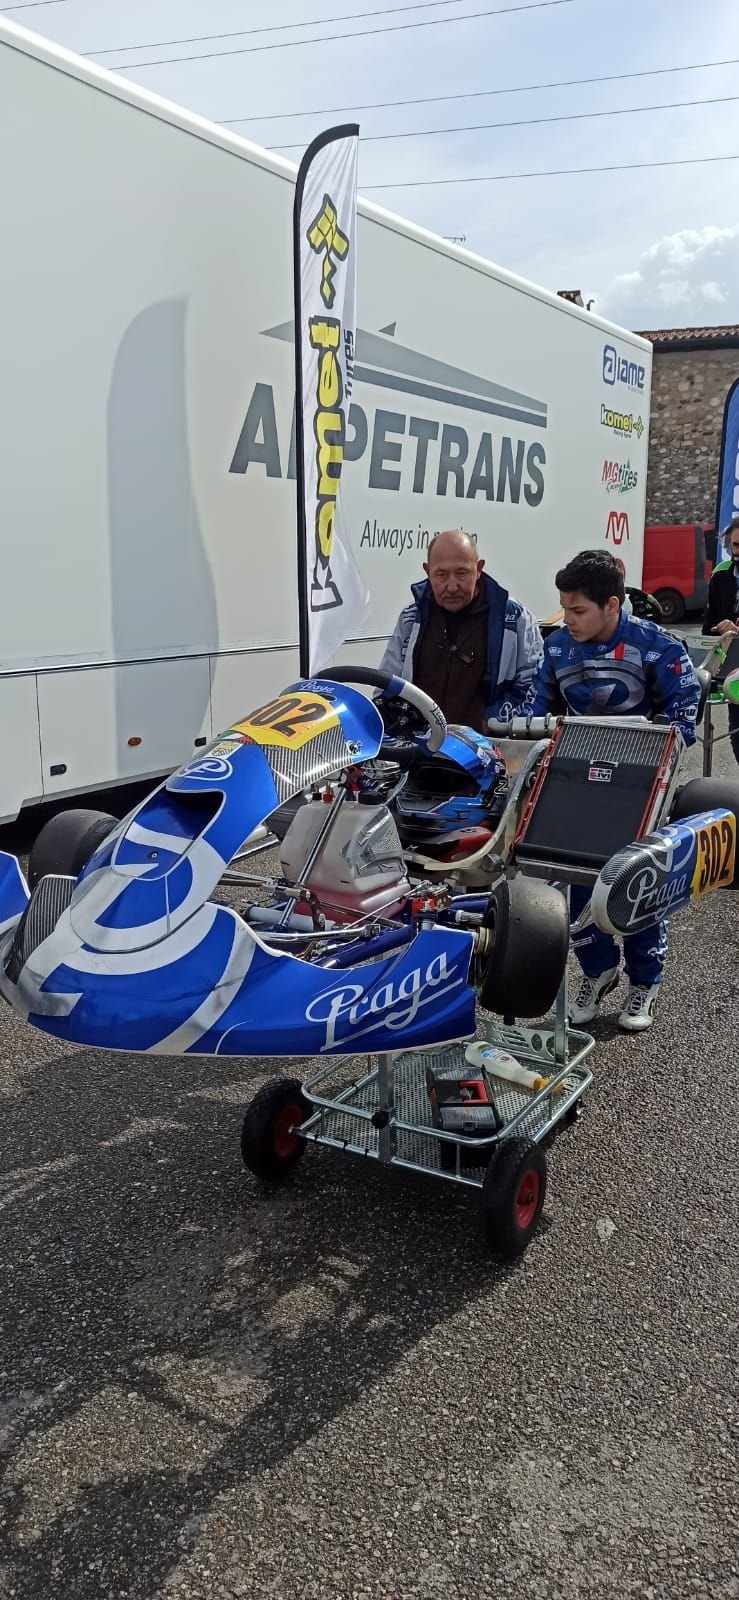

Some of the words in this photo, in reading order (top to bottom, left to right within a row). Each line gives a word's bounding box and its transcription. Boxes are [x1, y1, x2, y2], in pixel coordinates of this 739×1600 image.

[228, 382, 547, 507] APETRANS
[360, 519, 414, 556] Always
[416, 523, 429, 549] in
[699, 820, 733, 892] 302
[626, 866, 687, 926] Praga
[305, 951, 463, 1052] Praga
